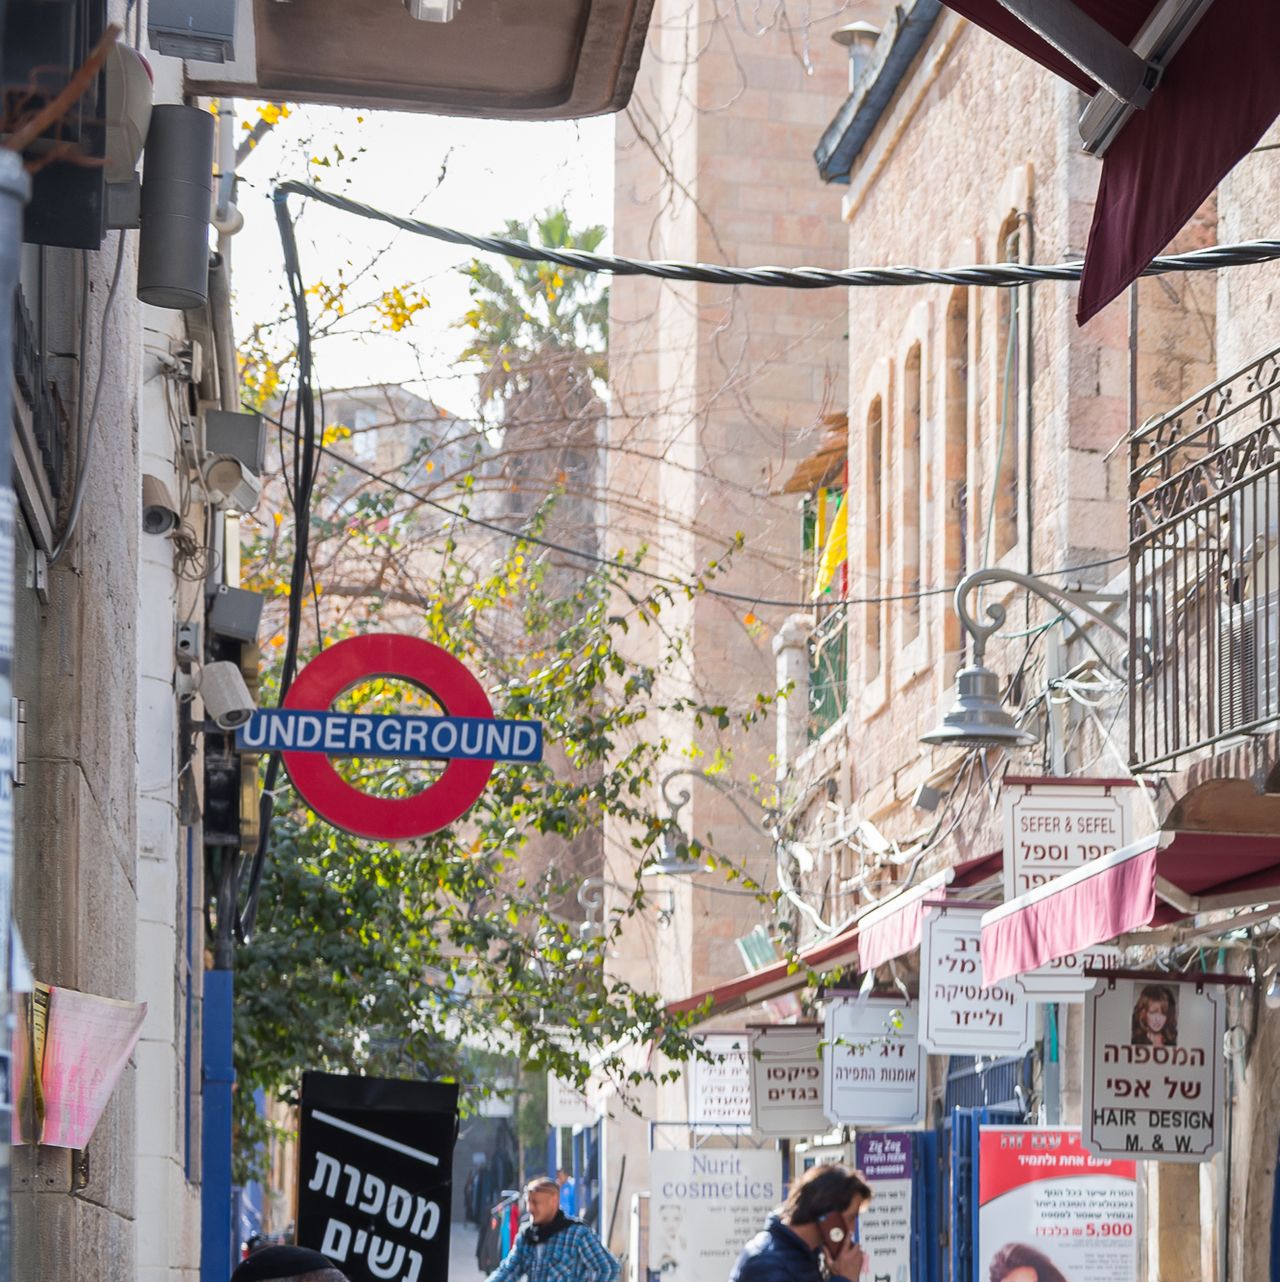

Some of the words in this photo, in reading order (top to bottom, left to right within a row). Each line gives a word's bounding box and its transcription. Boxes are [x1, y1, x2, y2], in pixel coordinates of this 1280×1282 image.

[243, 714, 537, 756] UNDERGROUND
[1020, 815, 1060, 833] SEFER
[1065, 816, 1073, 833] &
[1077, 816, 1116, 834] SEFEL
[1021, 841, 1068, 861] וספל
[953, 937, 980, 952] רב
[938, 955, 981, 974] מלי
[950, 1008, 1003, 1027] ולייזר
[1104, 1044, 1206, 1067] המספרה
[767, 1066, 820, 1083] פיקסו
[836, 1066, 875, 1082] התפירה
[881, 1066, 916, 1083] אומנות
[768, 1086, 819, 1101] בגדים
[1106, 1078, 1152, 1098] אפי
[1164, 1075, 1202, 1099] של
[1093, 1109, 1136, 1126] HAIR
[1149, 1110, 1214, 1129] DESIGN
[1126, 1134, 1144, 1152] M.
[1152, 1135, 1164, 1152] &
[1175, 1135, 1194, 1153] W.
[692, 1155, 742, 1175] Nurit
[1018, 1153, 1056, 1167] ולתמיד
[1059, 1155, 1085, 1167] אחת
[309, 1151, 441, 1241] מספרת
[662, 1176, 774, 1200] cosmetics
[1086, 1222, 1133, 1237] 5,900
